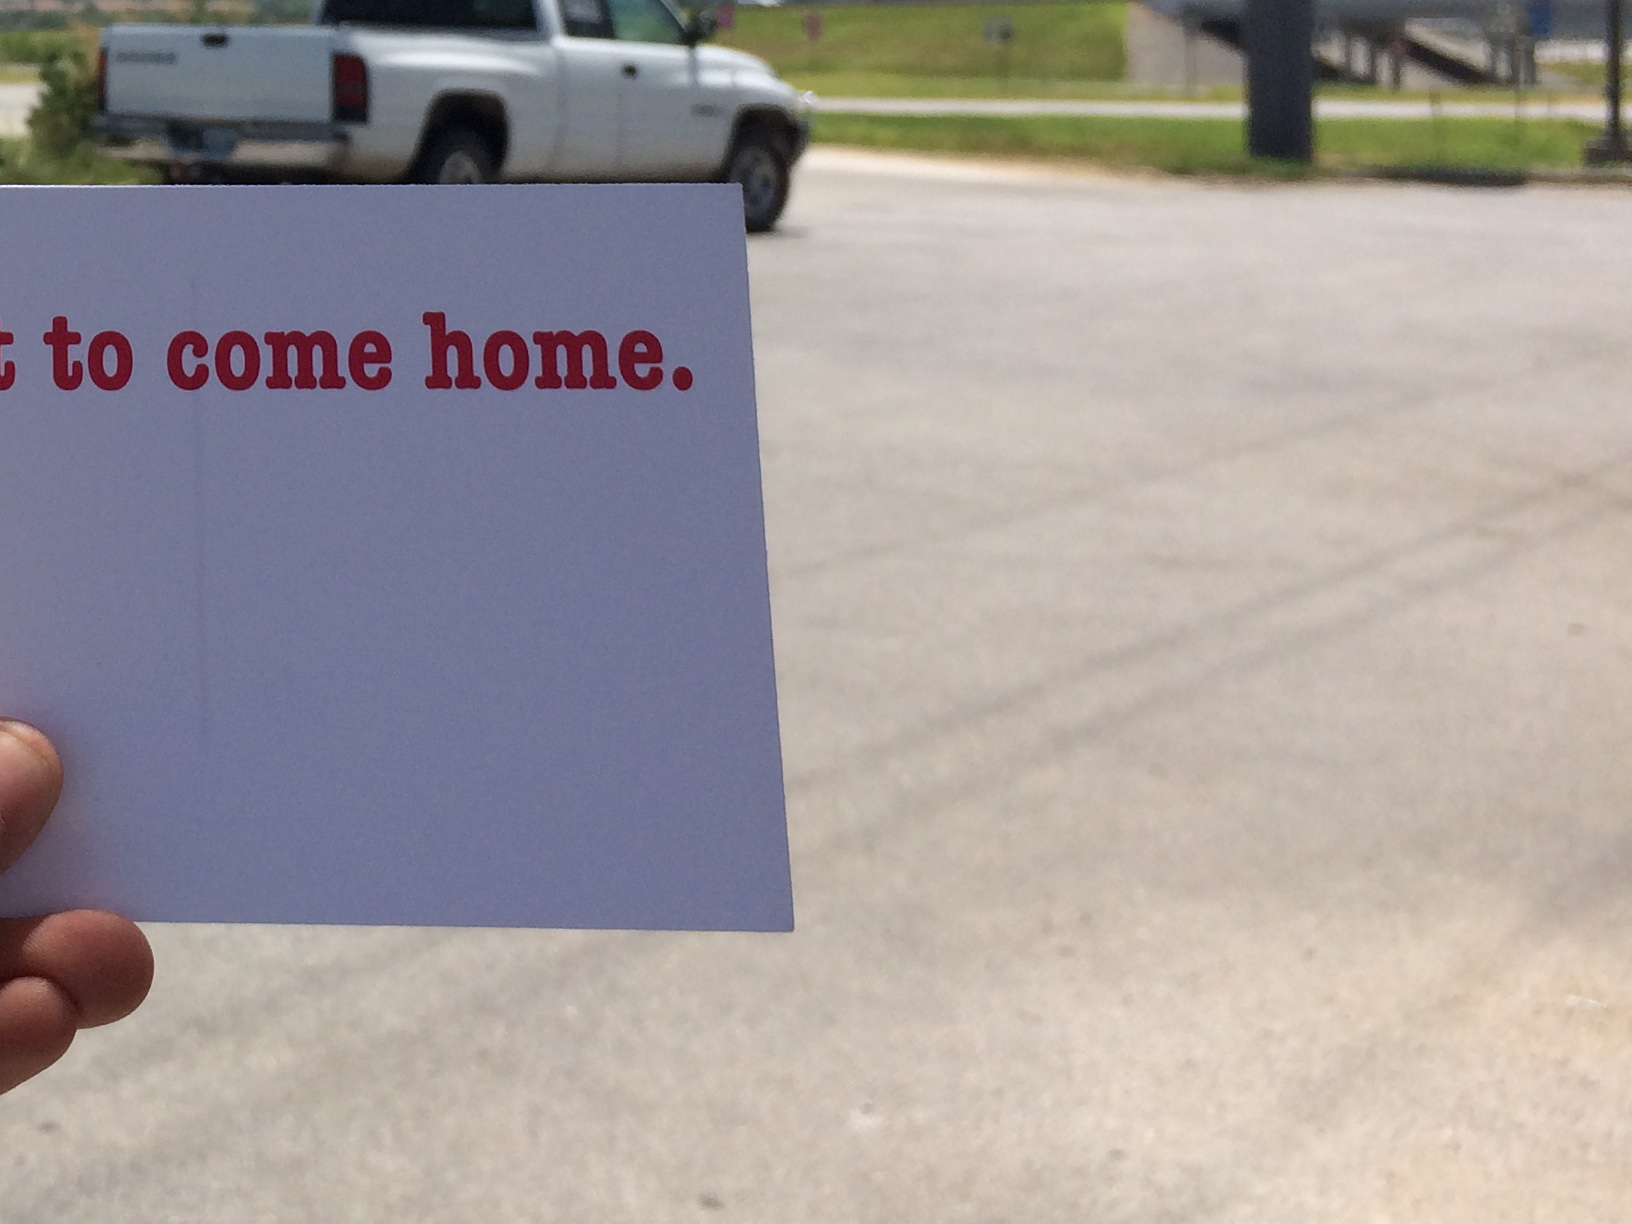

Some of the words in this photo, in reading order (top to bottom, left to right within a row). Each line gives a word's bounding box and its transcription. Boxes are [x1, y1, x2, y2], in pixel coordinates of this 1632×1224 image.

[43, 316, 133, 391] to
[167, 330, 392, 391] come
[422, 312, 693, 391] home.
